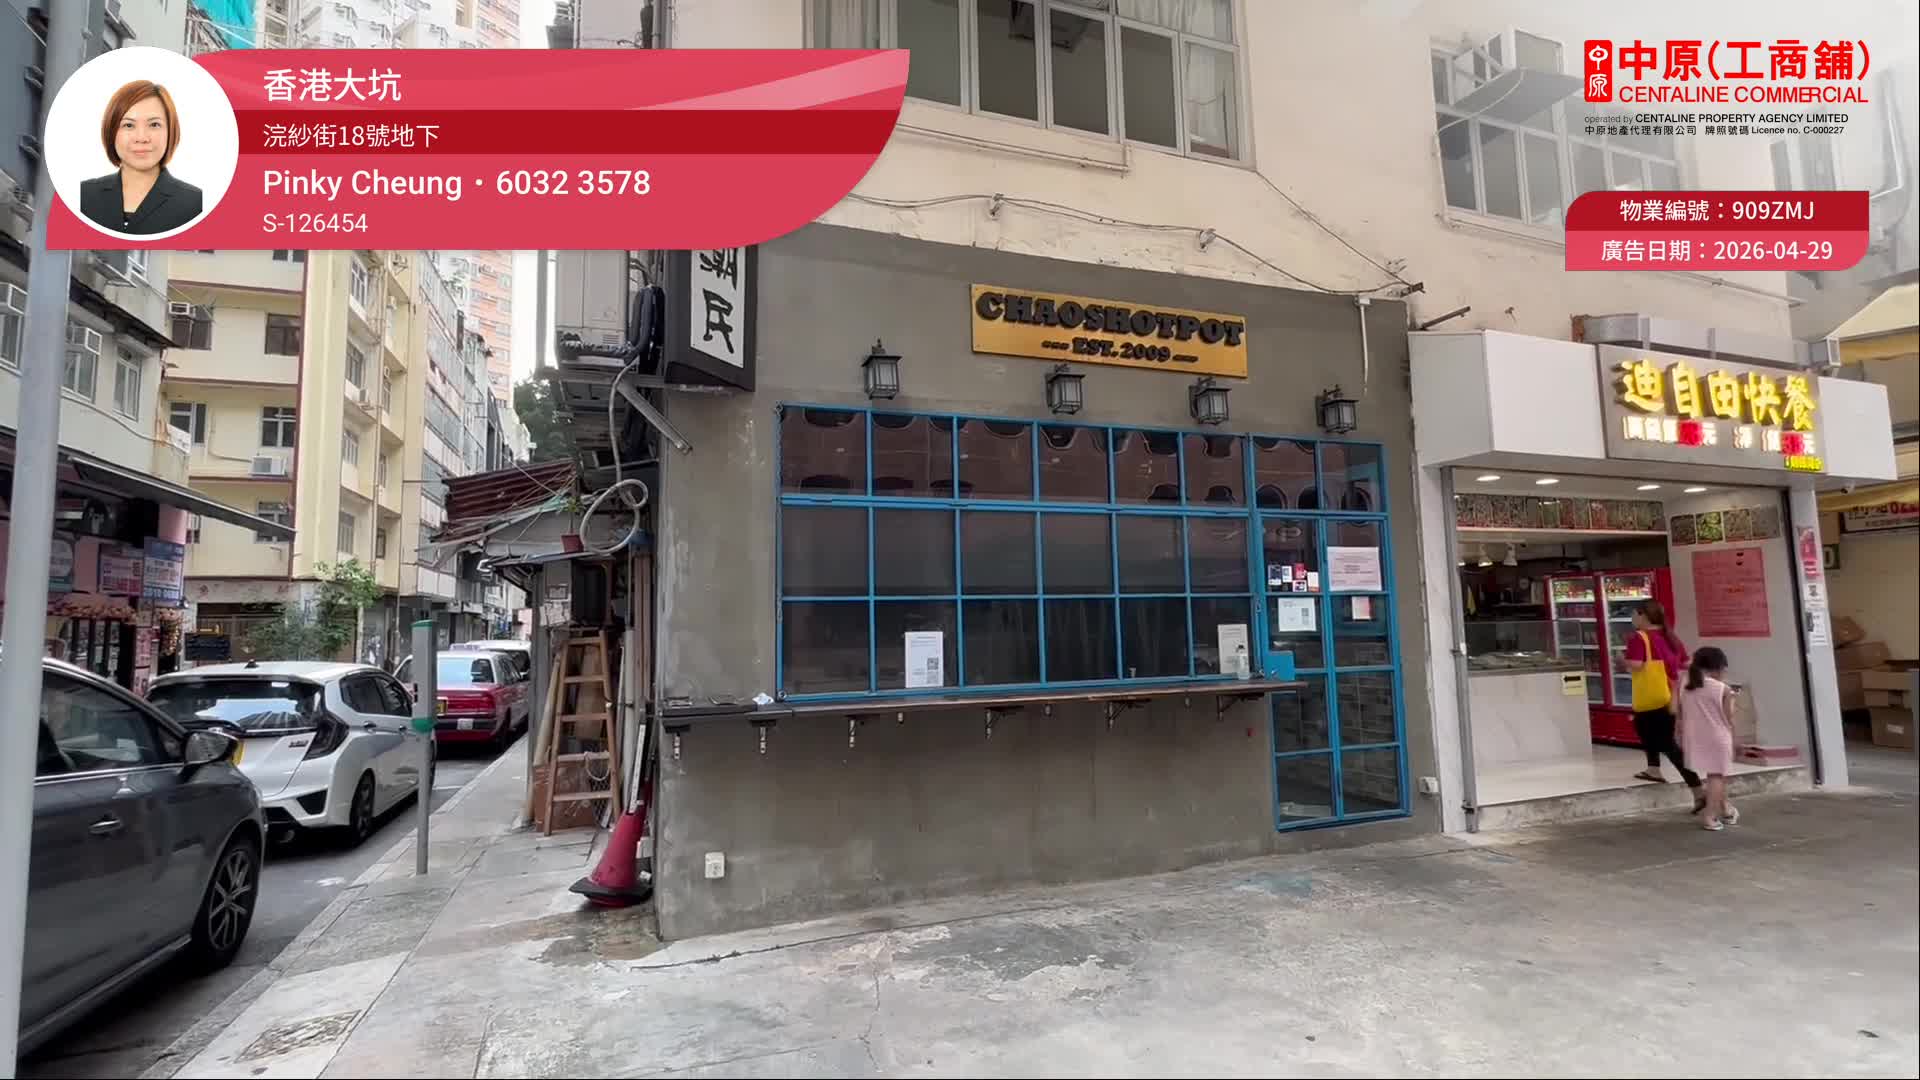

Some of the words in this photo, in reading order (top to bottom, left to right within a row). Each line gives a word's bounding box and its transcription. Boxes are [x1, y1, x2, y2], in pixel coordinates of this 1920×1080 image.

[975, 291, 1244, 346] CHAOSHOTPOT
[1071, 337, 1118, 358] EST.
[1119, 341, 1171, 364] 2009
